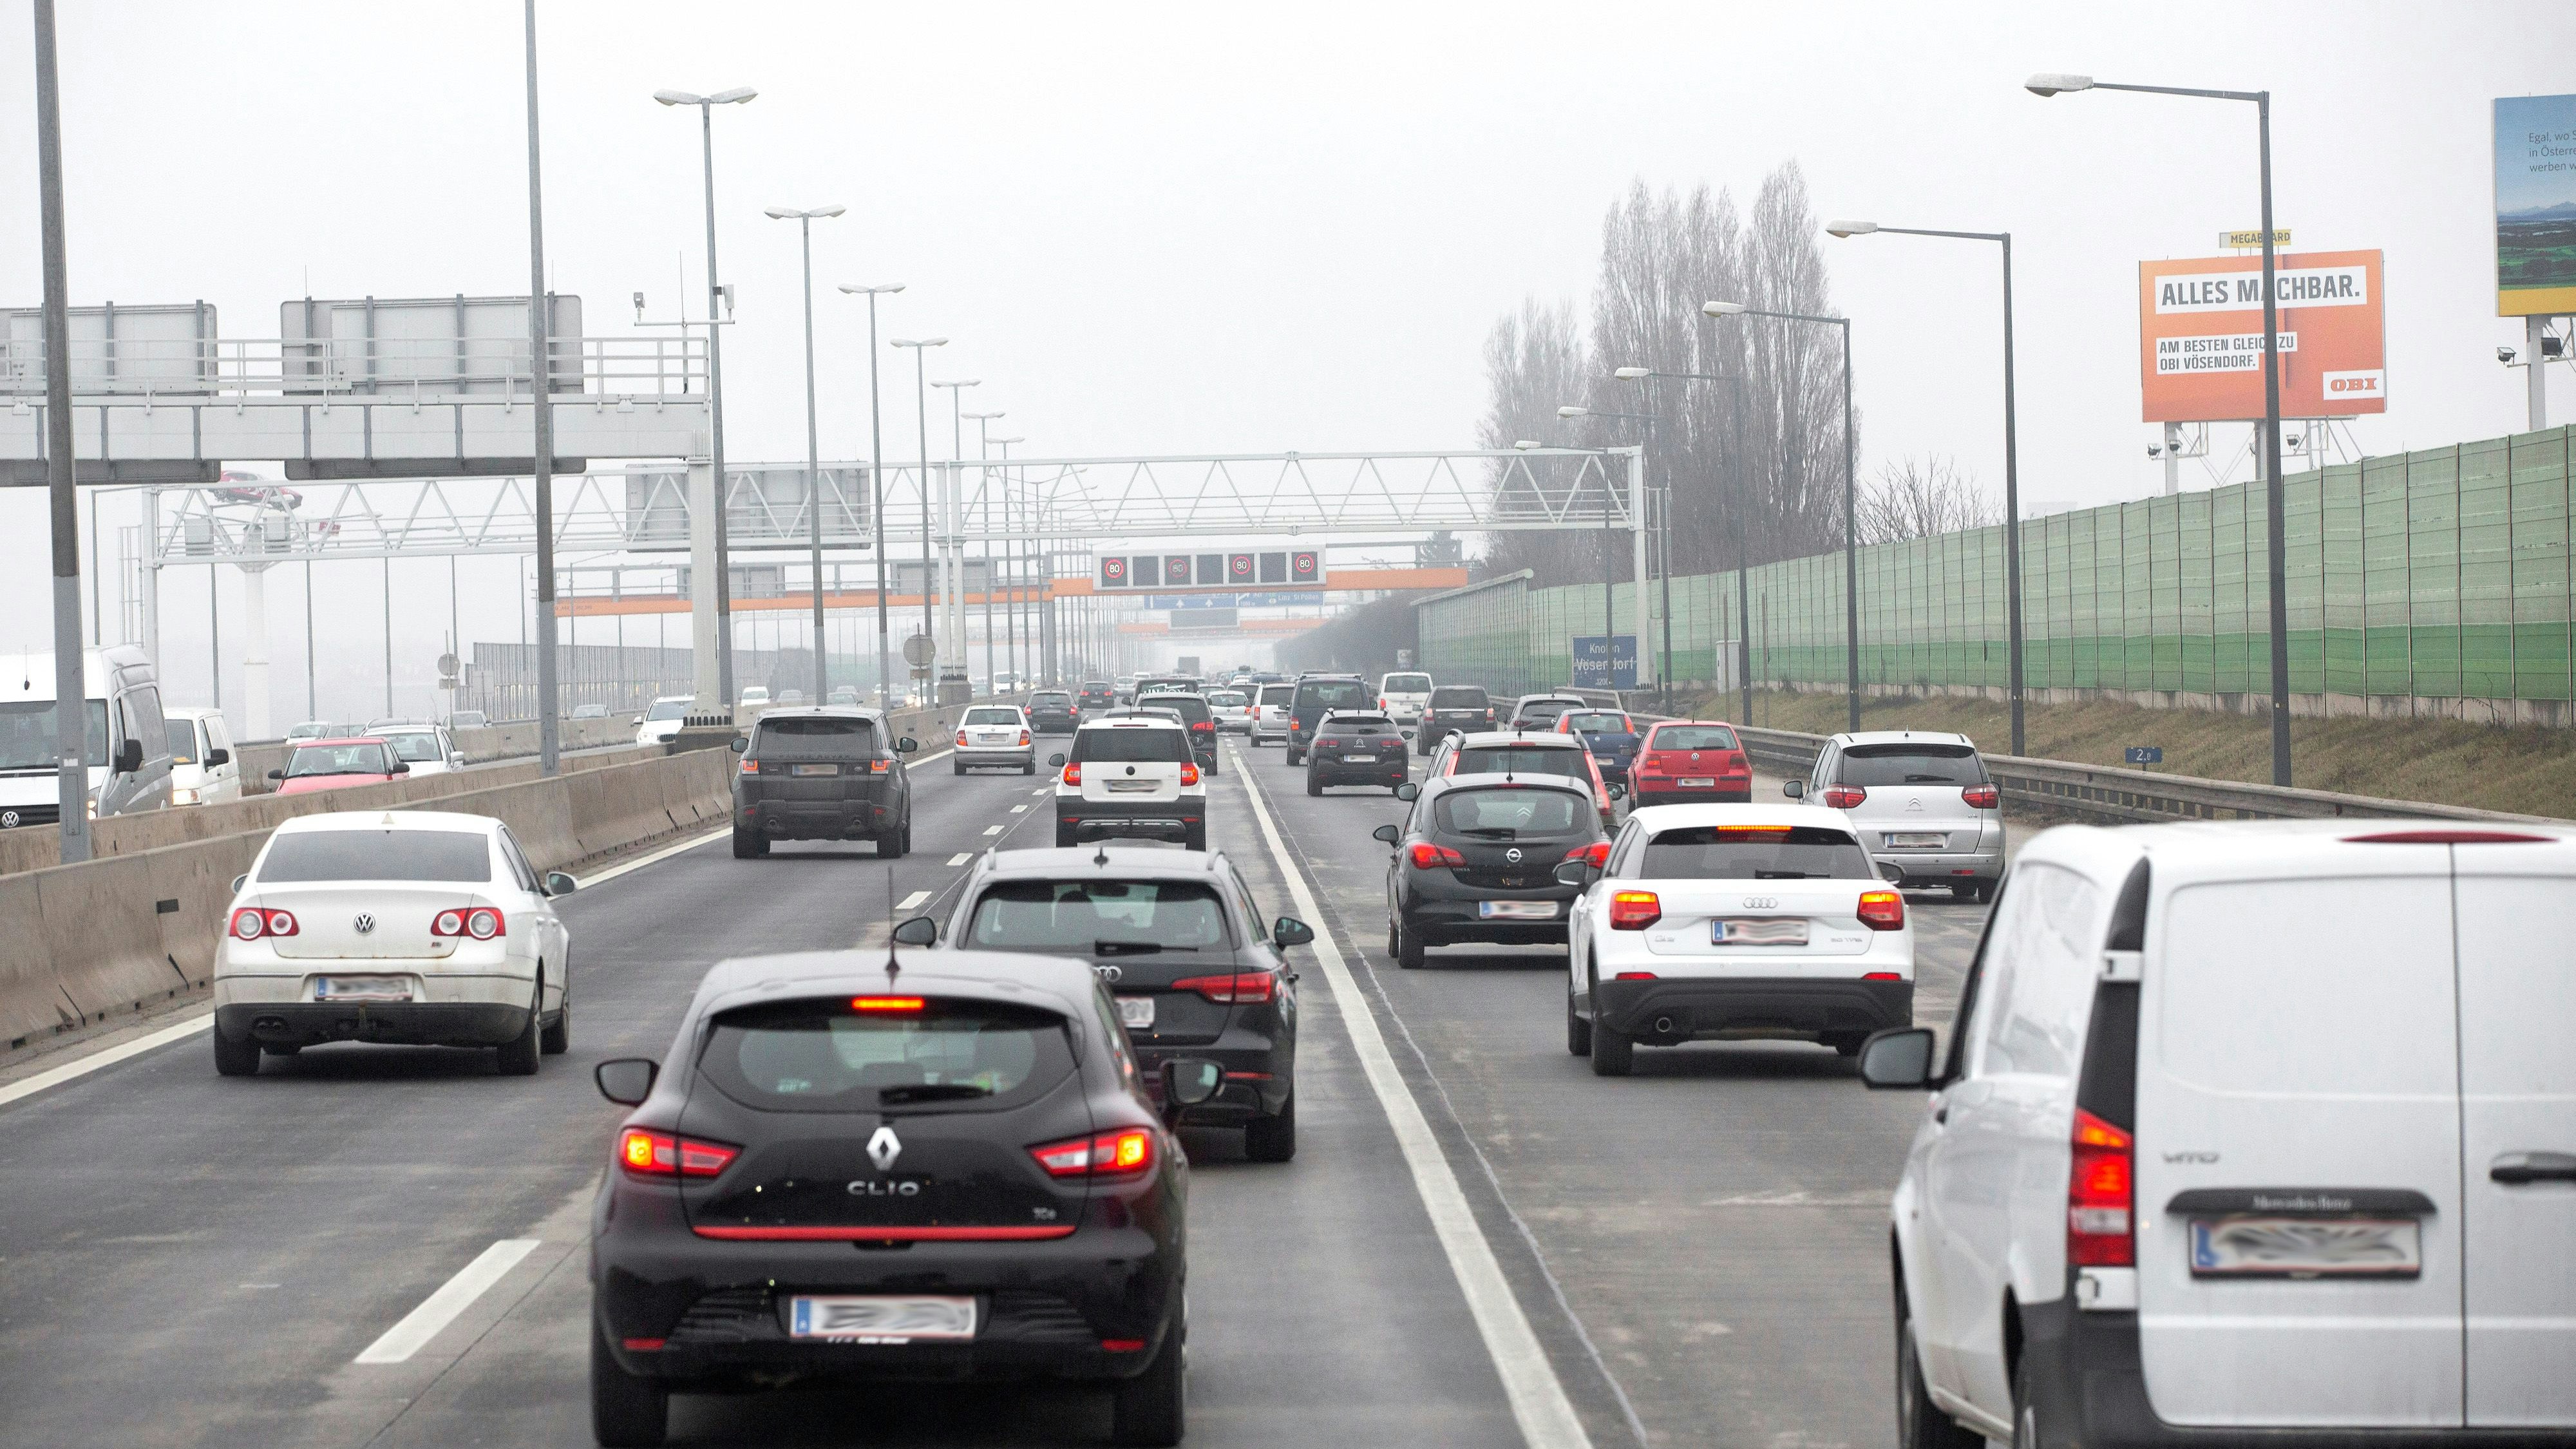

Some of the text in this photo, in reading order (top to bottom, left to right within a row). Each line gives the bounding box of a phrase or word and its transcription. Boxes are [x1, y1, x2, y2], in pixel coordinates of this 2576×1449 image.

[2529, 131, 2552, 144] Egal,
[2529, 147, 2538, 157] in
[2530, 161, 2566, 172] werben
[2231, 232, 2290, 243] MEGABARD
[2161, 275, 2360, 306] ALLES MCHBAR.
[2159, 336, 2294, 354] AM BESTEN GLEIC ZU
[2160, 354, 2255, 370] OBI VÖSENDORF.
[2330, 377, 2377, 392] OBI
[1109, 564, 1121, 573] 80
[1172, 564, 1184, 573] 80
[1236, 561, 1247, 570] 80
[1300, 559, 1311, 568] 80
[1589, 643, 1620, 654] Knon
[847, 1180, 920, 1196] CLIO
